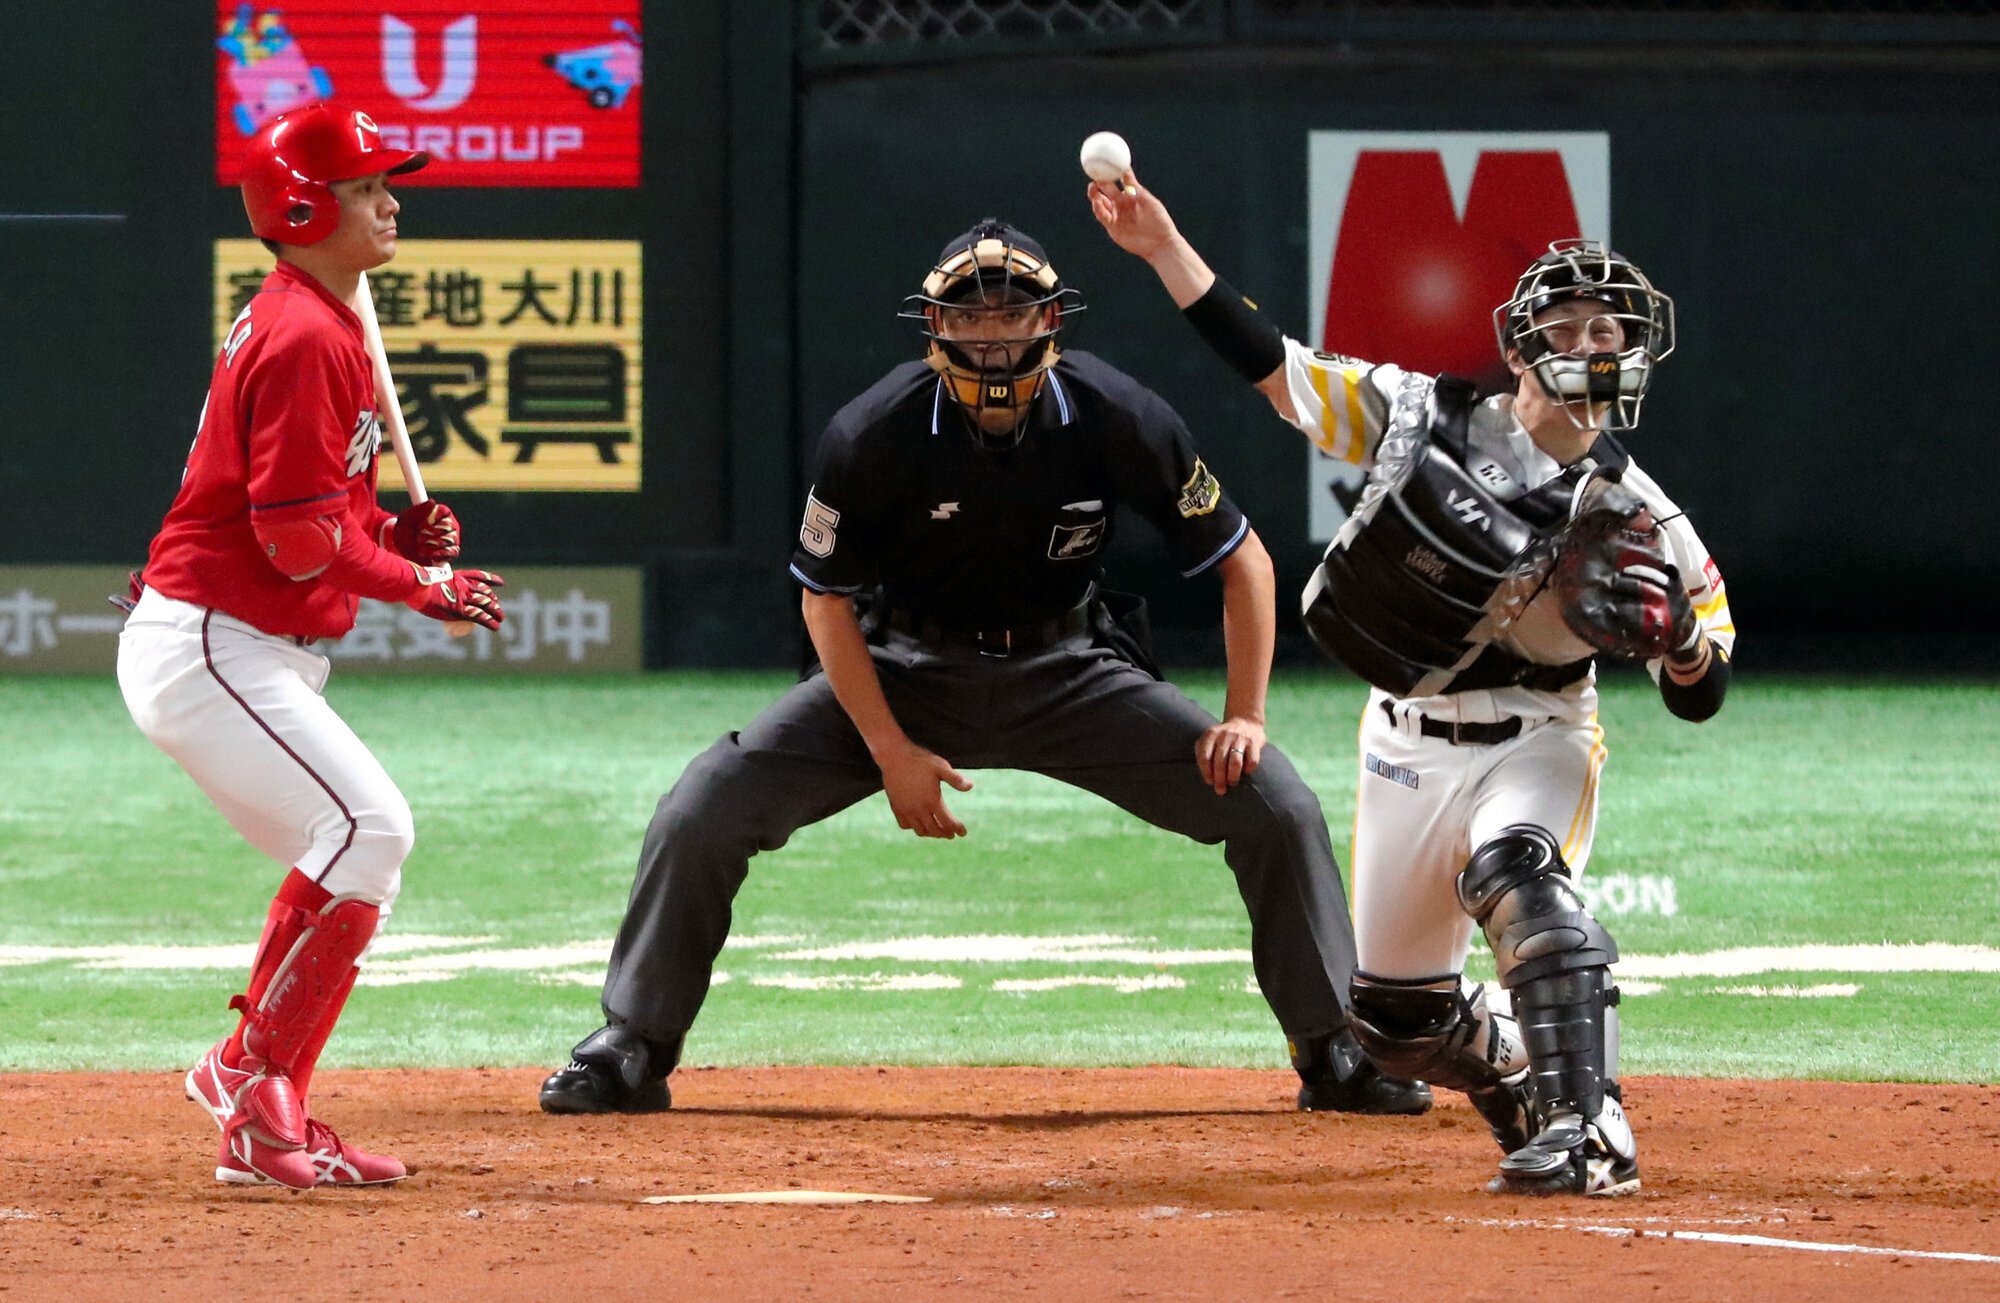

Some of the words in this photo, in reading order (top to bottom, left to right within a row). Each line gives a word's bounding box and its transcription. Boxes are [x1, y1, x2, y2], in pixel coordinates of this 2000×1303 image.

[380, 14, 478, 111] U
[378, 126, 583, 161] GROUP
[377, 340, 632, 464] 家具
[801, 492, 840, 558] 5
